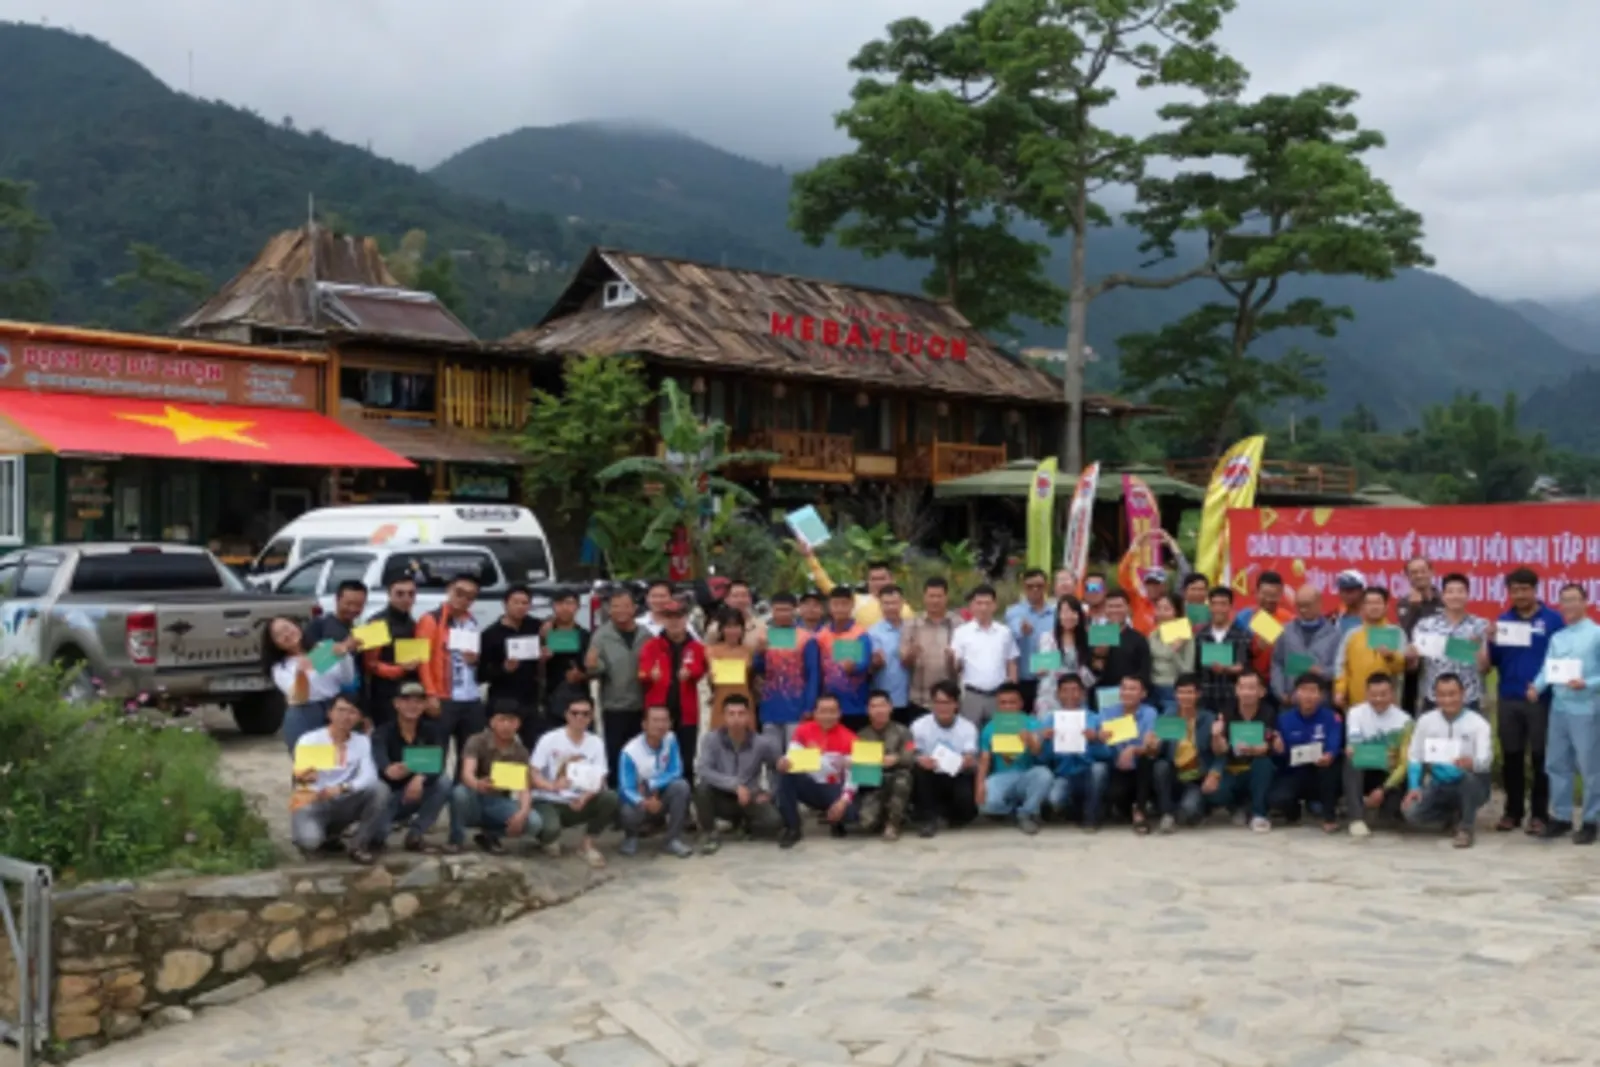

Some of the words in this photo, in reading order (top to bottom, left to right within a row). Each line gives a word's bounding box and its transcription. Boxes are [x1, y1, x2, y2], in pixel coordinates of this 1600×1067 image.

[770, 311, 968, 361] MEBAYLUON
[1418, 535, 1457, 561] THAM
[1484, 531, 1508, 567] HỘI
[1552, 531, 1584, 568] TẬP
